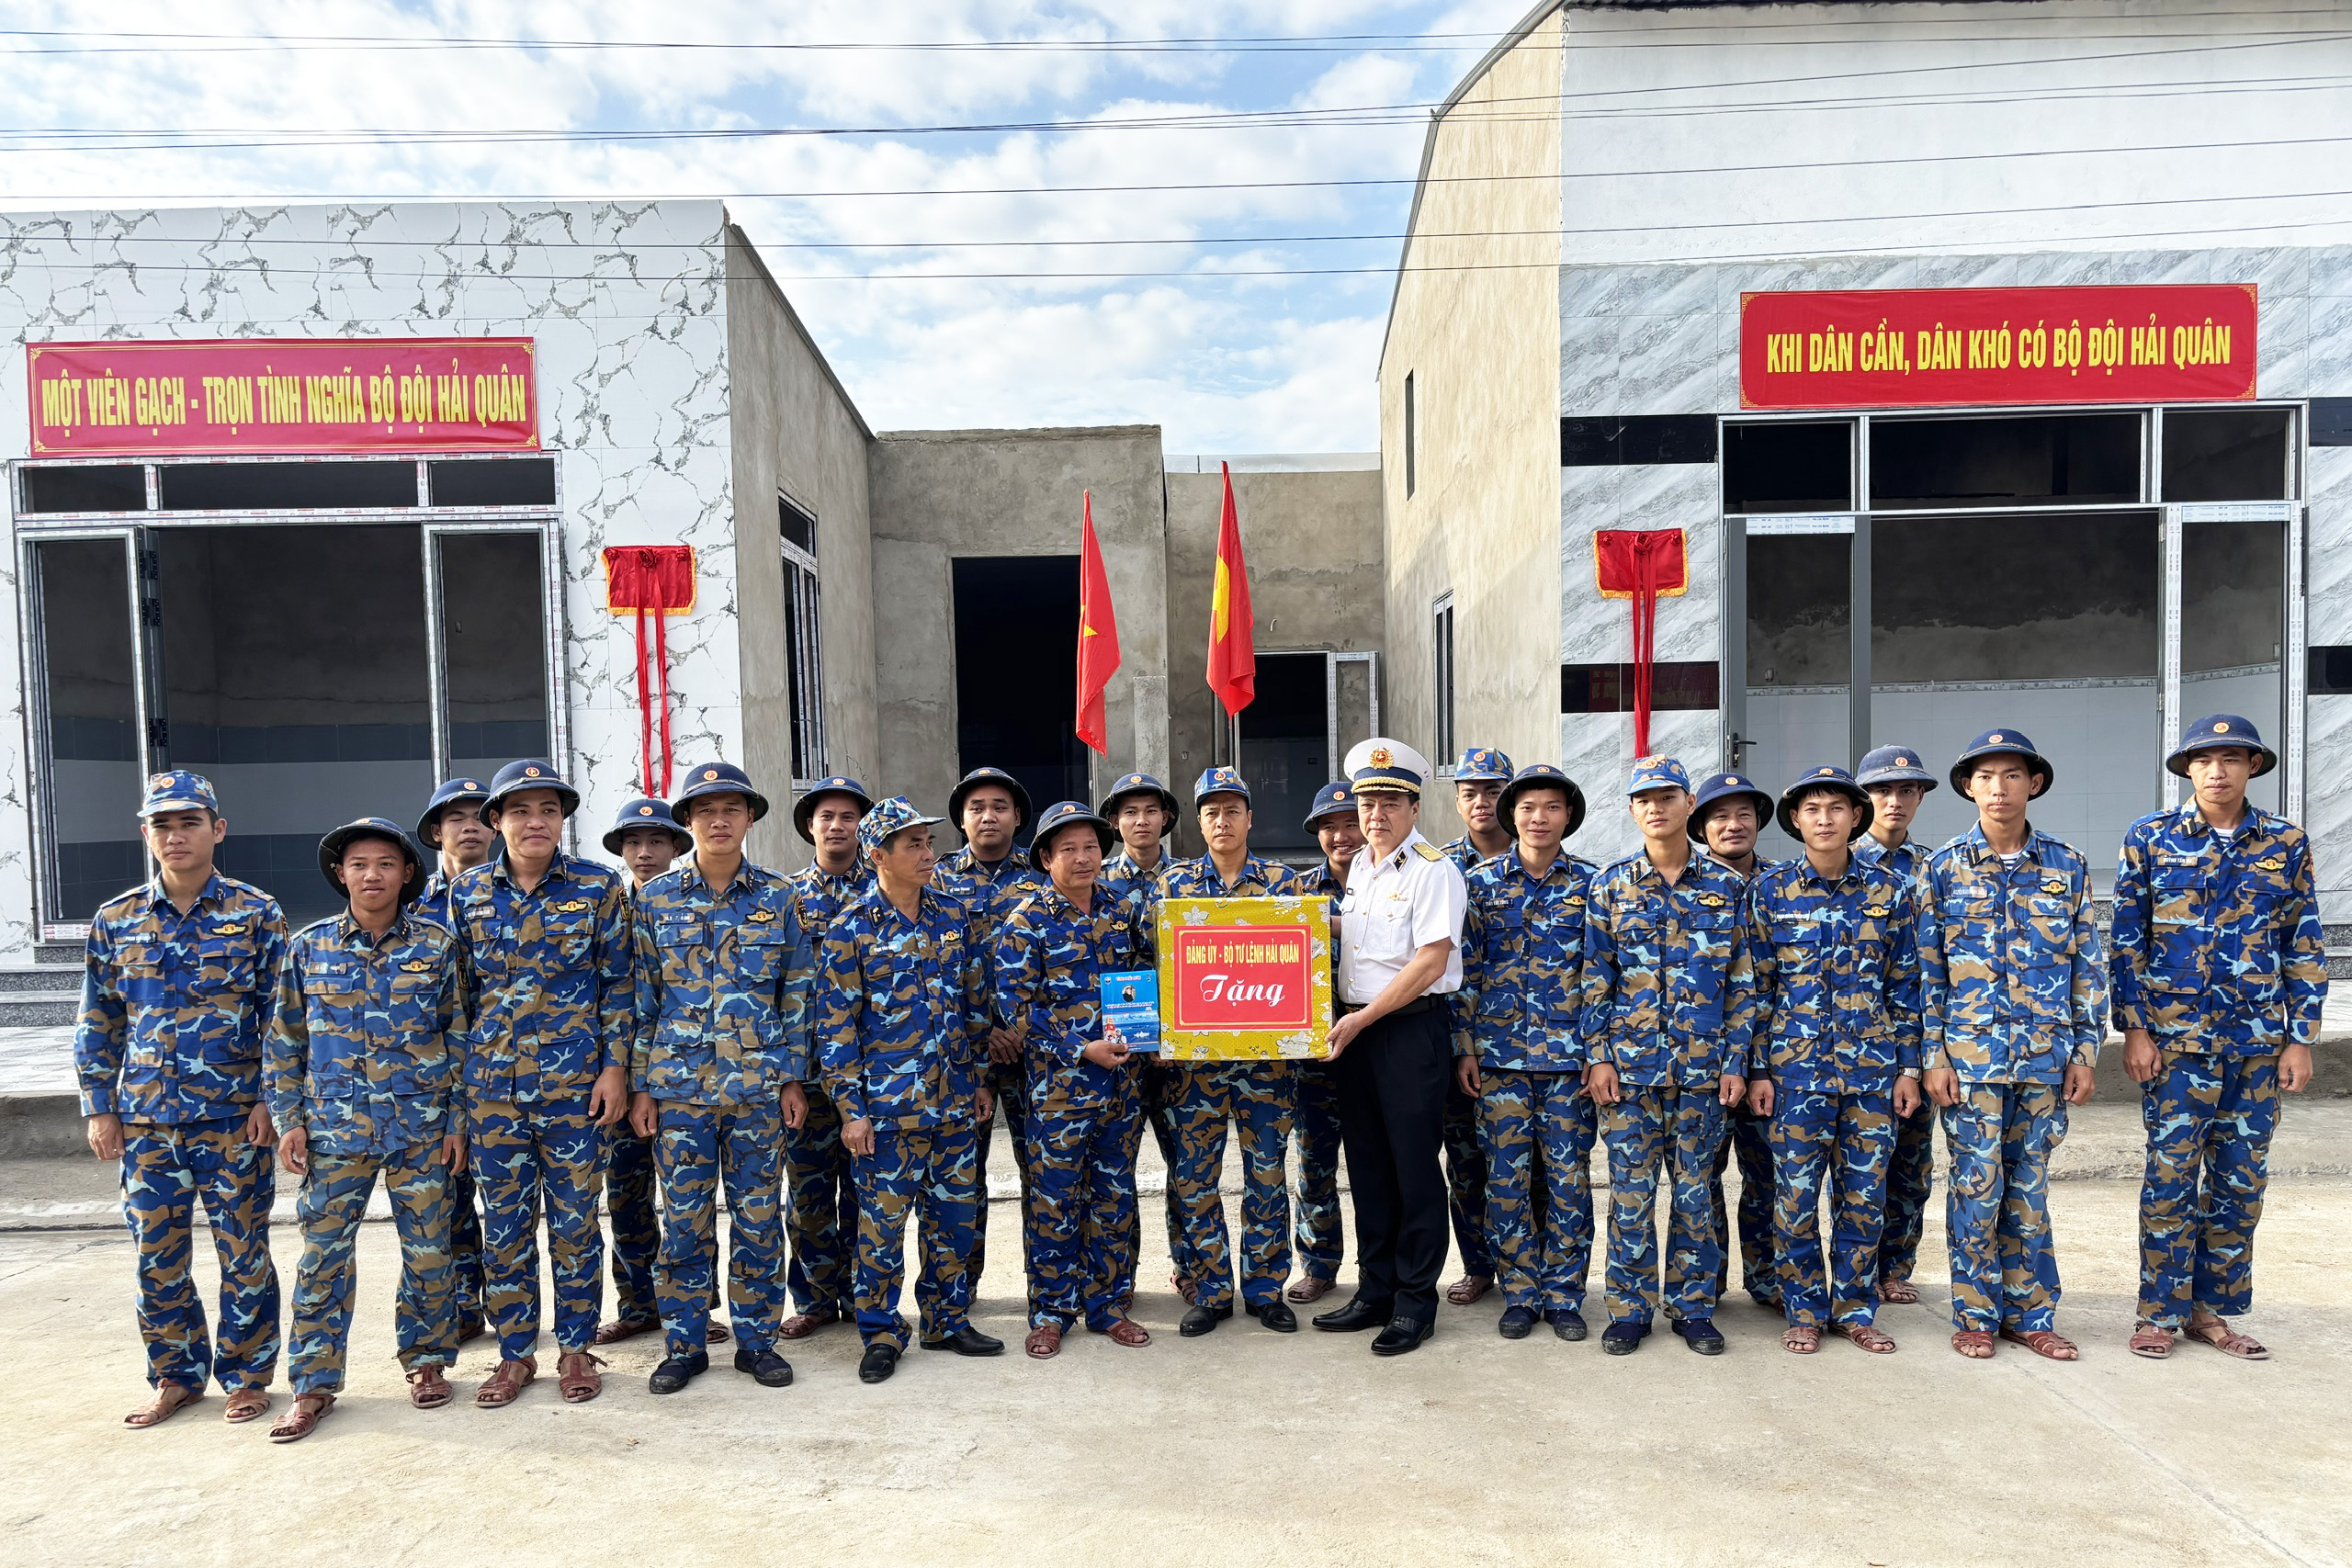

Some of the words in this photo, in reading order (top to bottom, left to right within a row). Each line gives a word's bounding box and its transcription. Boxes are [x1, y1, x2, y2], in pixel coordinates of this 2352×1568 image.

[1767, 333, 1802, 373] KHI
[1809, 324, 1852, 372] DÂN
[1860, 318, 1910, 376] CẦN,
[1917, 322, 1962, 370] DÂN
[1968, 321, 2010, 369] KHÓ
[2018, 320, 2046, 368] CÓ
[2052, 319, 2082, 377] BỘ
[2087, 318, 2124, 376] ĐỘI
[2131, 312, 2166, 366] HẢI
[2173, 317, 2231, 370] QUÂN
[41, 368, 82, 437] MỘT
[86, 367, 130, 426] VIÊN
[135, 378, 187, 436] GẠCH
[202, 376, 253, 434] TRỌN
[257, 365, 301, 423] TÌNH
[306, 367, 366, 423] NGHĨA
[369, 364, 396, 433] BỘ
[400, 364, 433, 433] ĐỘI
[437, 357, 469, 423] HẢI
[474, 364, 526, 427] QUÂN
[1186, 939, 1206, 964] ĐẢNG
[1207, 939, 1217, 964] ỦY
[1224, 941, 1234, 967] BỘ
[1235, 942, 1245, 964] TƯ
[1246, 941, 1264, 967] LỆNH
[1265, 938, 1278, 964] HẢI
[1279, 941, 1300, 964] QUÂN
[1199, 974, 1286, 1007] Tặng
